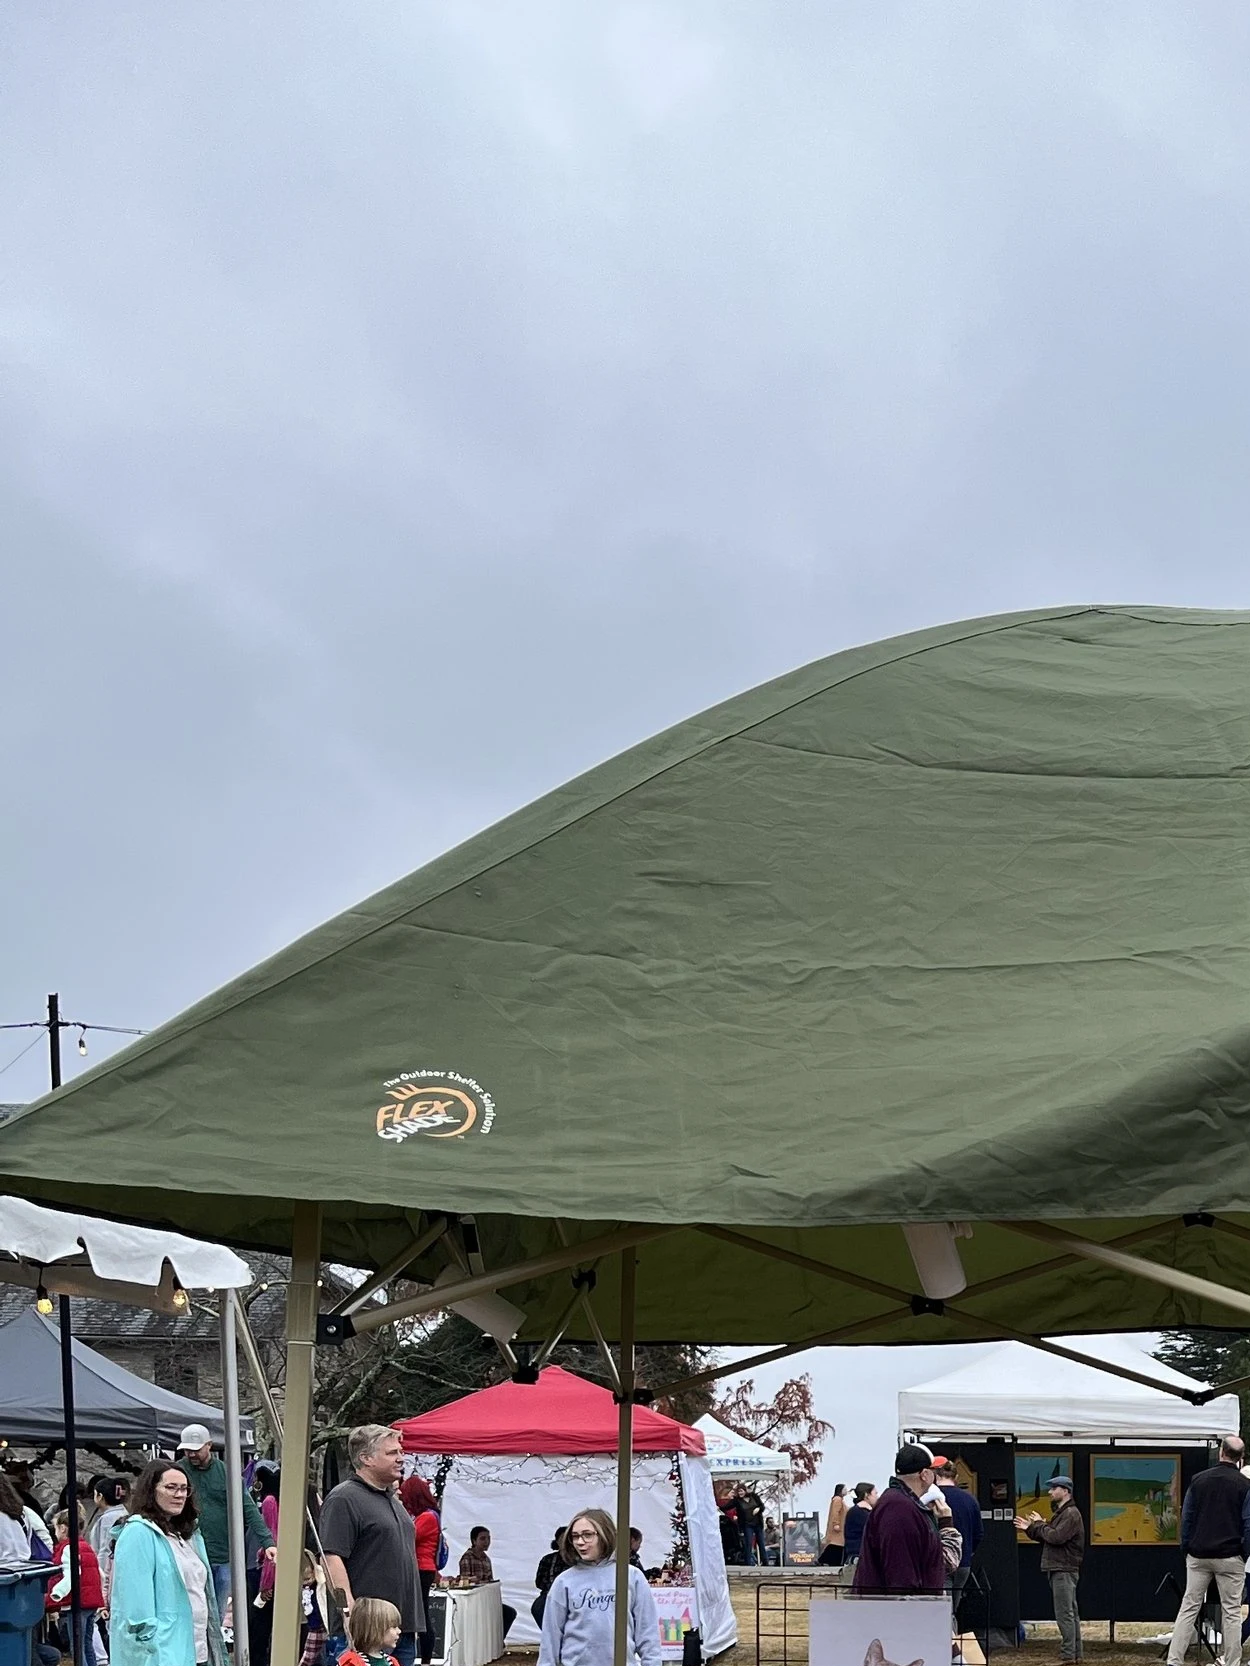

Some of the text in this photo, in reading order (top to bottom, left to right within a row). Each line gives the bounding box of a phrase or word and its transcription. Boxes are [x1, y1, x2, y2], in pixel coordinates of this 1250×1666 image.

[376, 1101, 455, 1132] FLEX
[383, 1069, 497, 1134] The Outdoor Shelter Solution
[378, 1114, 461, 1143] SHADE
